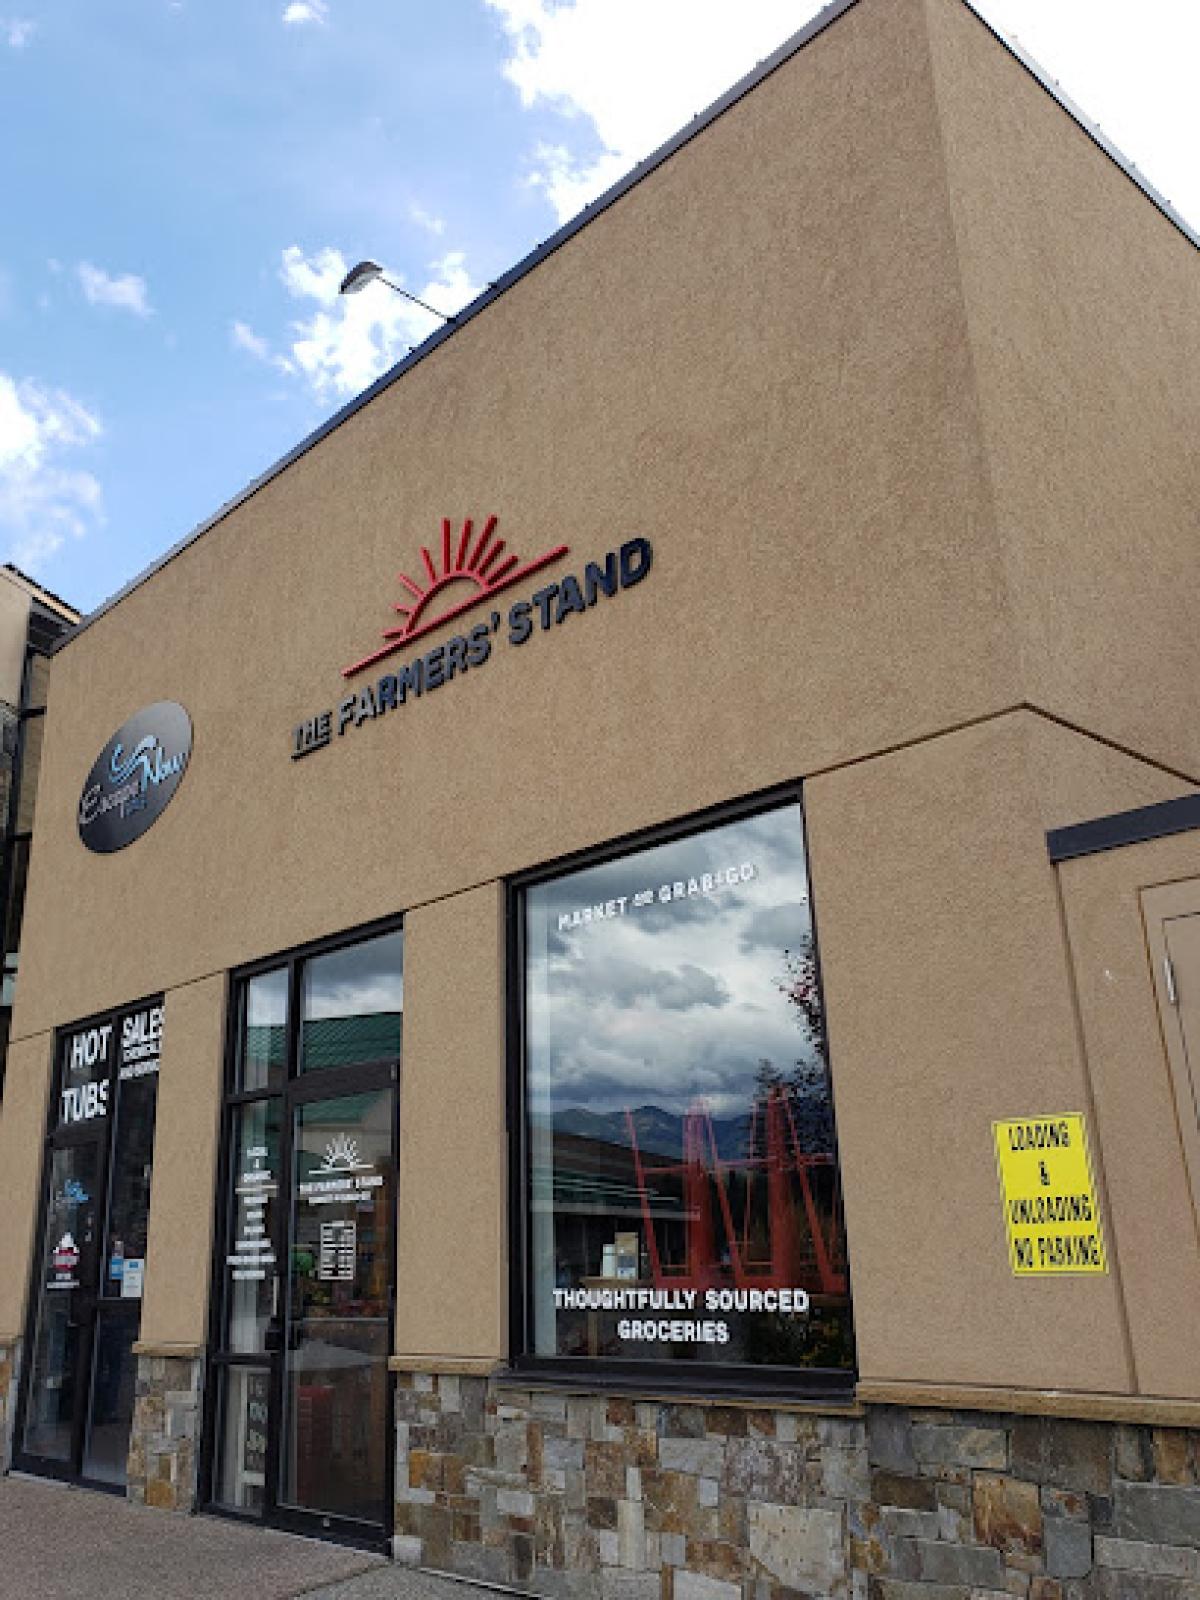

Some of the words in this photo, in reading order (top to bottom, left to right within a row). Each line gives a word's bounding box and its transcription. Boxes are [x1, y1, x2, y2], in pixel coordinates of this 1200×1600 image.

[291, 711, 332, 758] THE
[338, 612, 501, 736] FARMERS'
[508, 537, 653, 645] STAND
[558, 897, 629, 931] MARKET
[70, 1024, 113, 1069] HOT
[62, 1079, 110, 1124] TUBS
[1008, 1121, 1069, 1150] LOADING
[1008, 1194, 1091, 1224] UNLOADING
[1014, 1237, 1033, 1268] NO
[1038, 1235, 1101, 1266] PARKING
[552, 1287, 698, 1310] THOUGHTFULLY
[705, 1288, 810, 1312] SOURCED
[617, 1319, 730, 1343] GROCERIES
